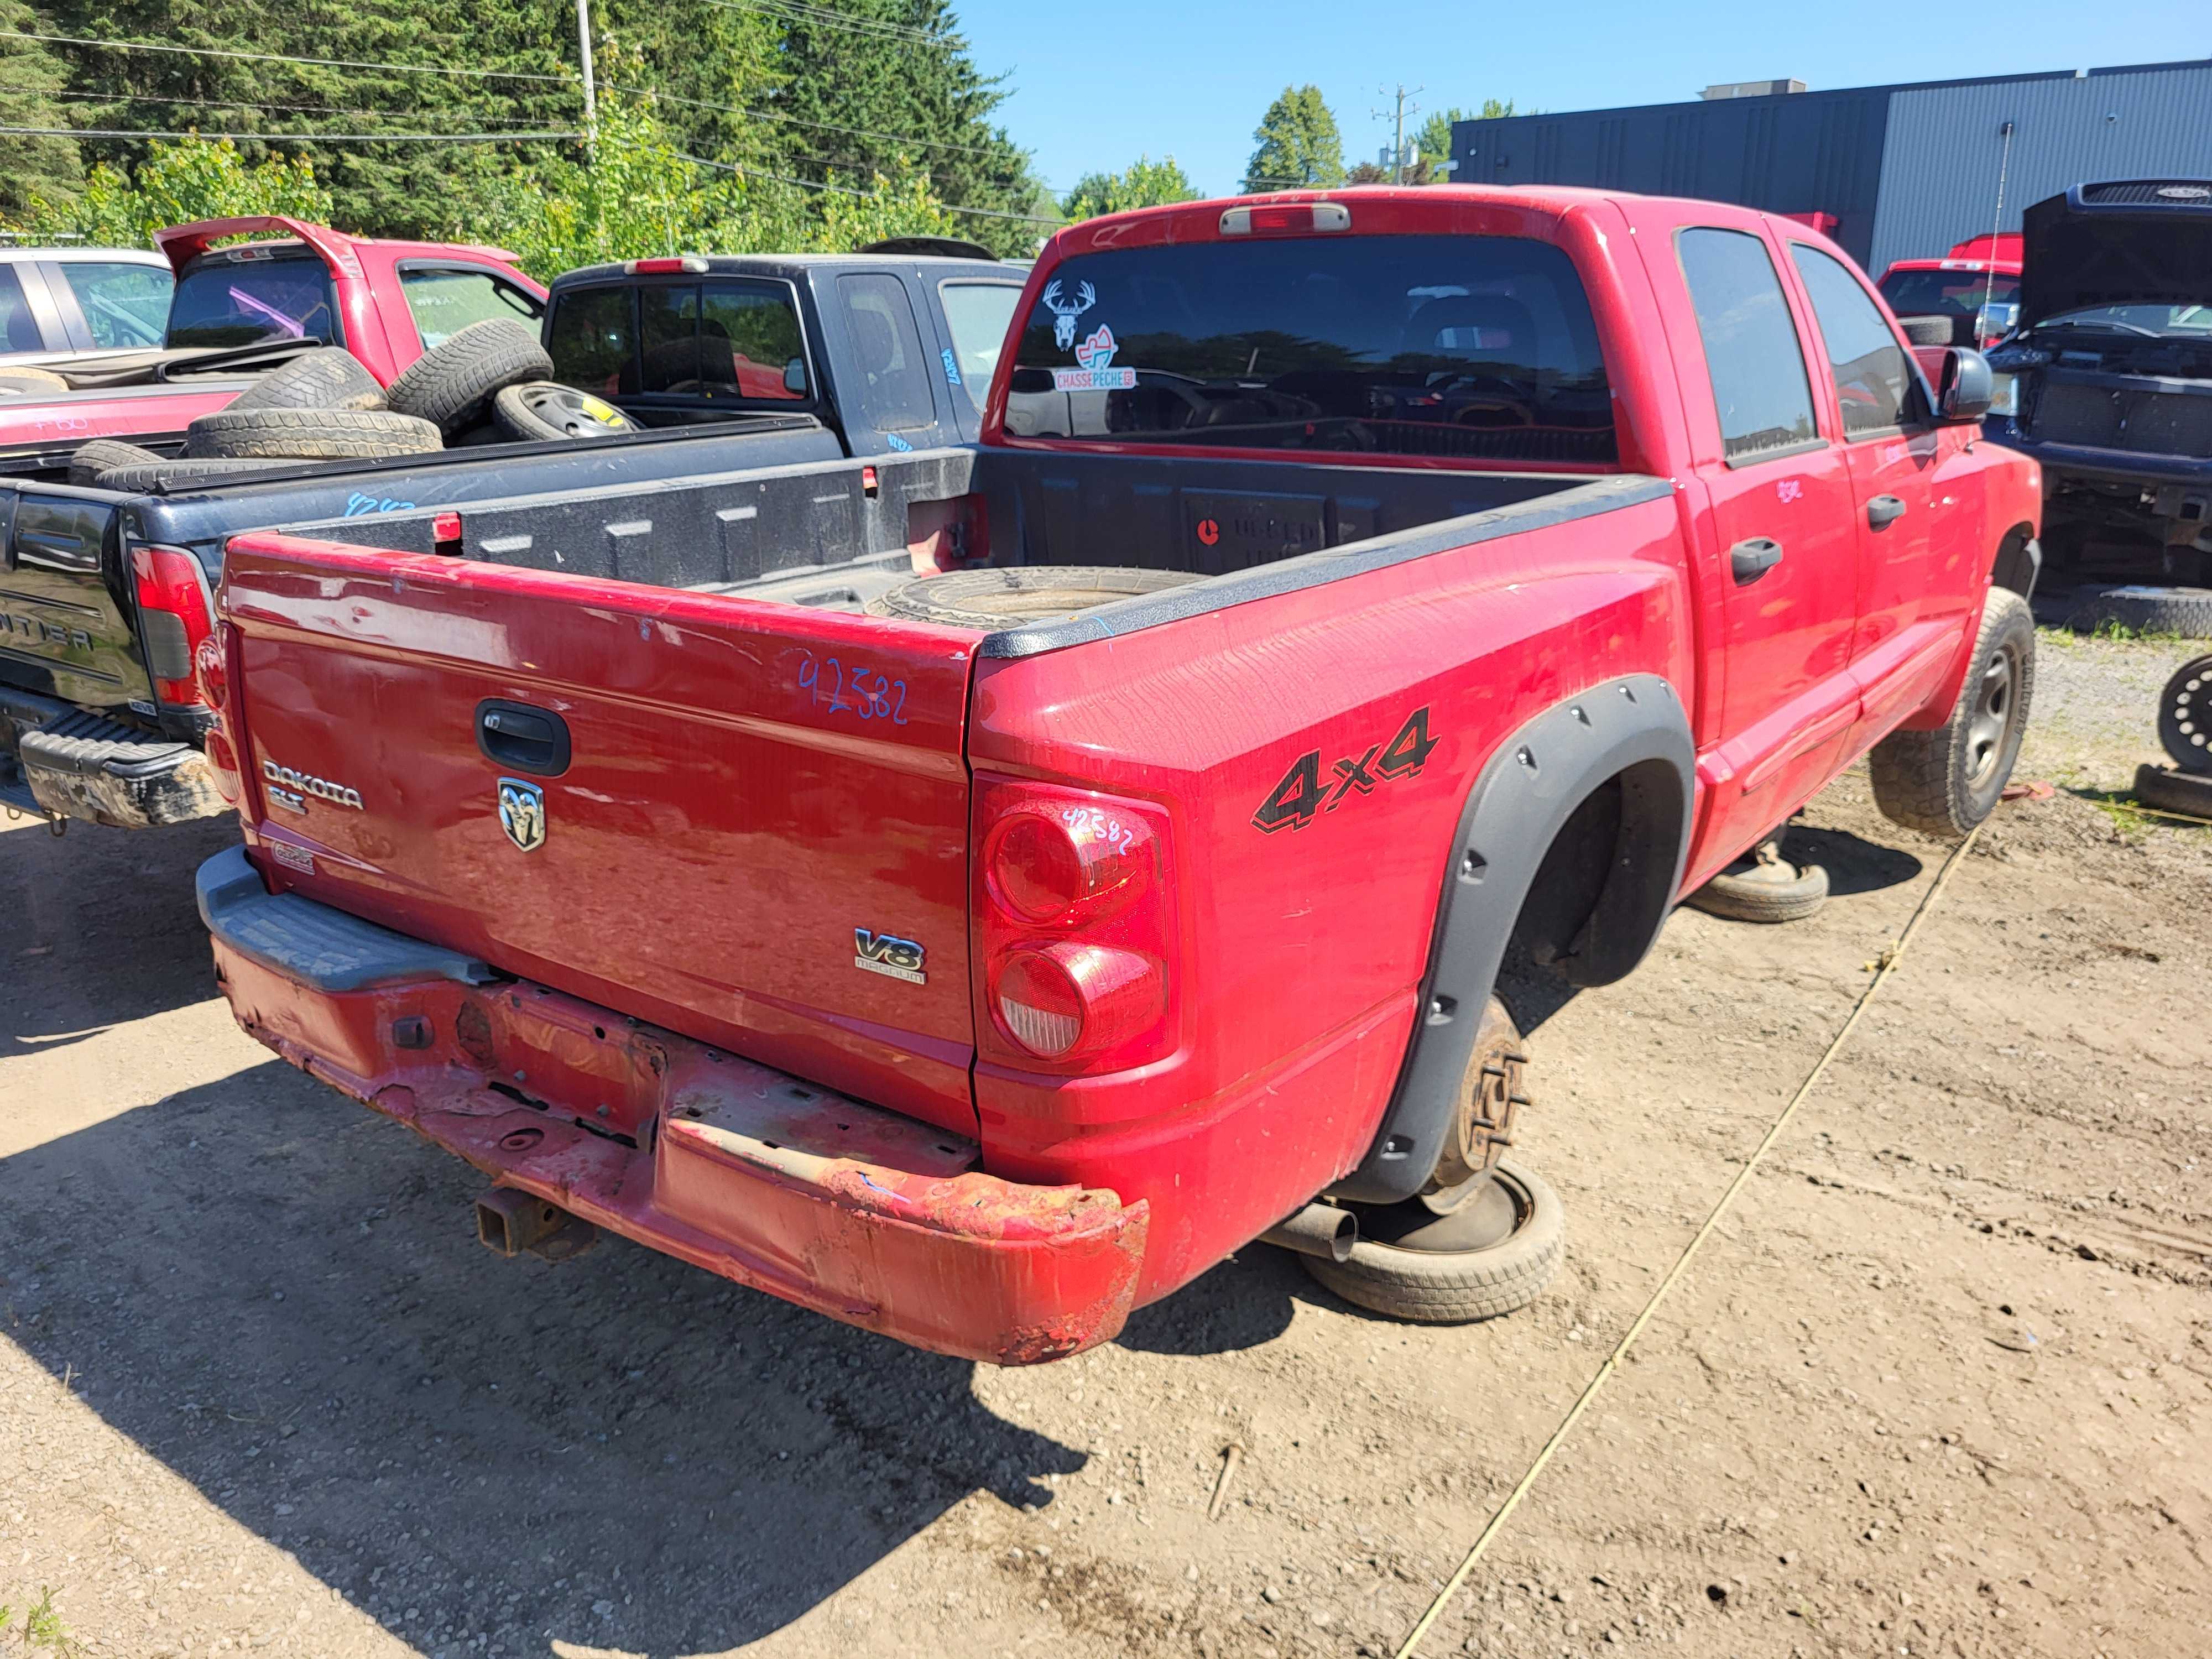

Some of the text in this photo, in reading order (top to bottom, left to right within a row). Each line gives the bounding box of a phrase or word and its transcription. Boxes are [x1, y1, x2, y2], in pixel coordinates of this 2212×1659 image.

[263, 760, 364, 811] DAKOTA
[1062, 807, 1133, 855] 42582
[854, 928, 925, 971] V8
